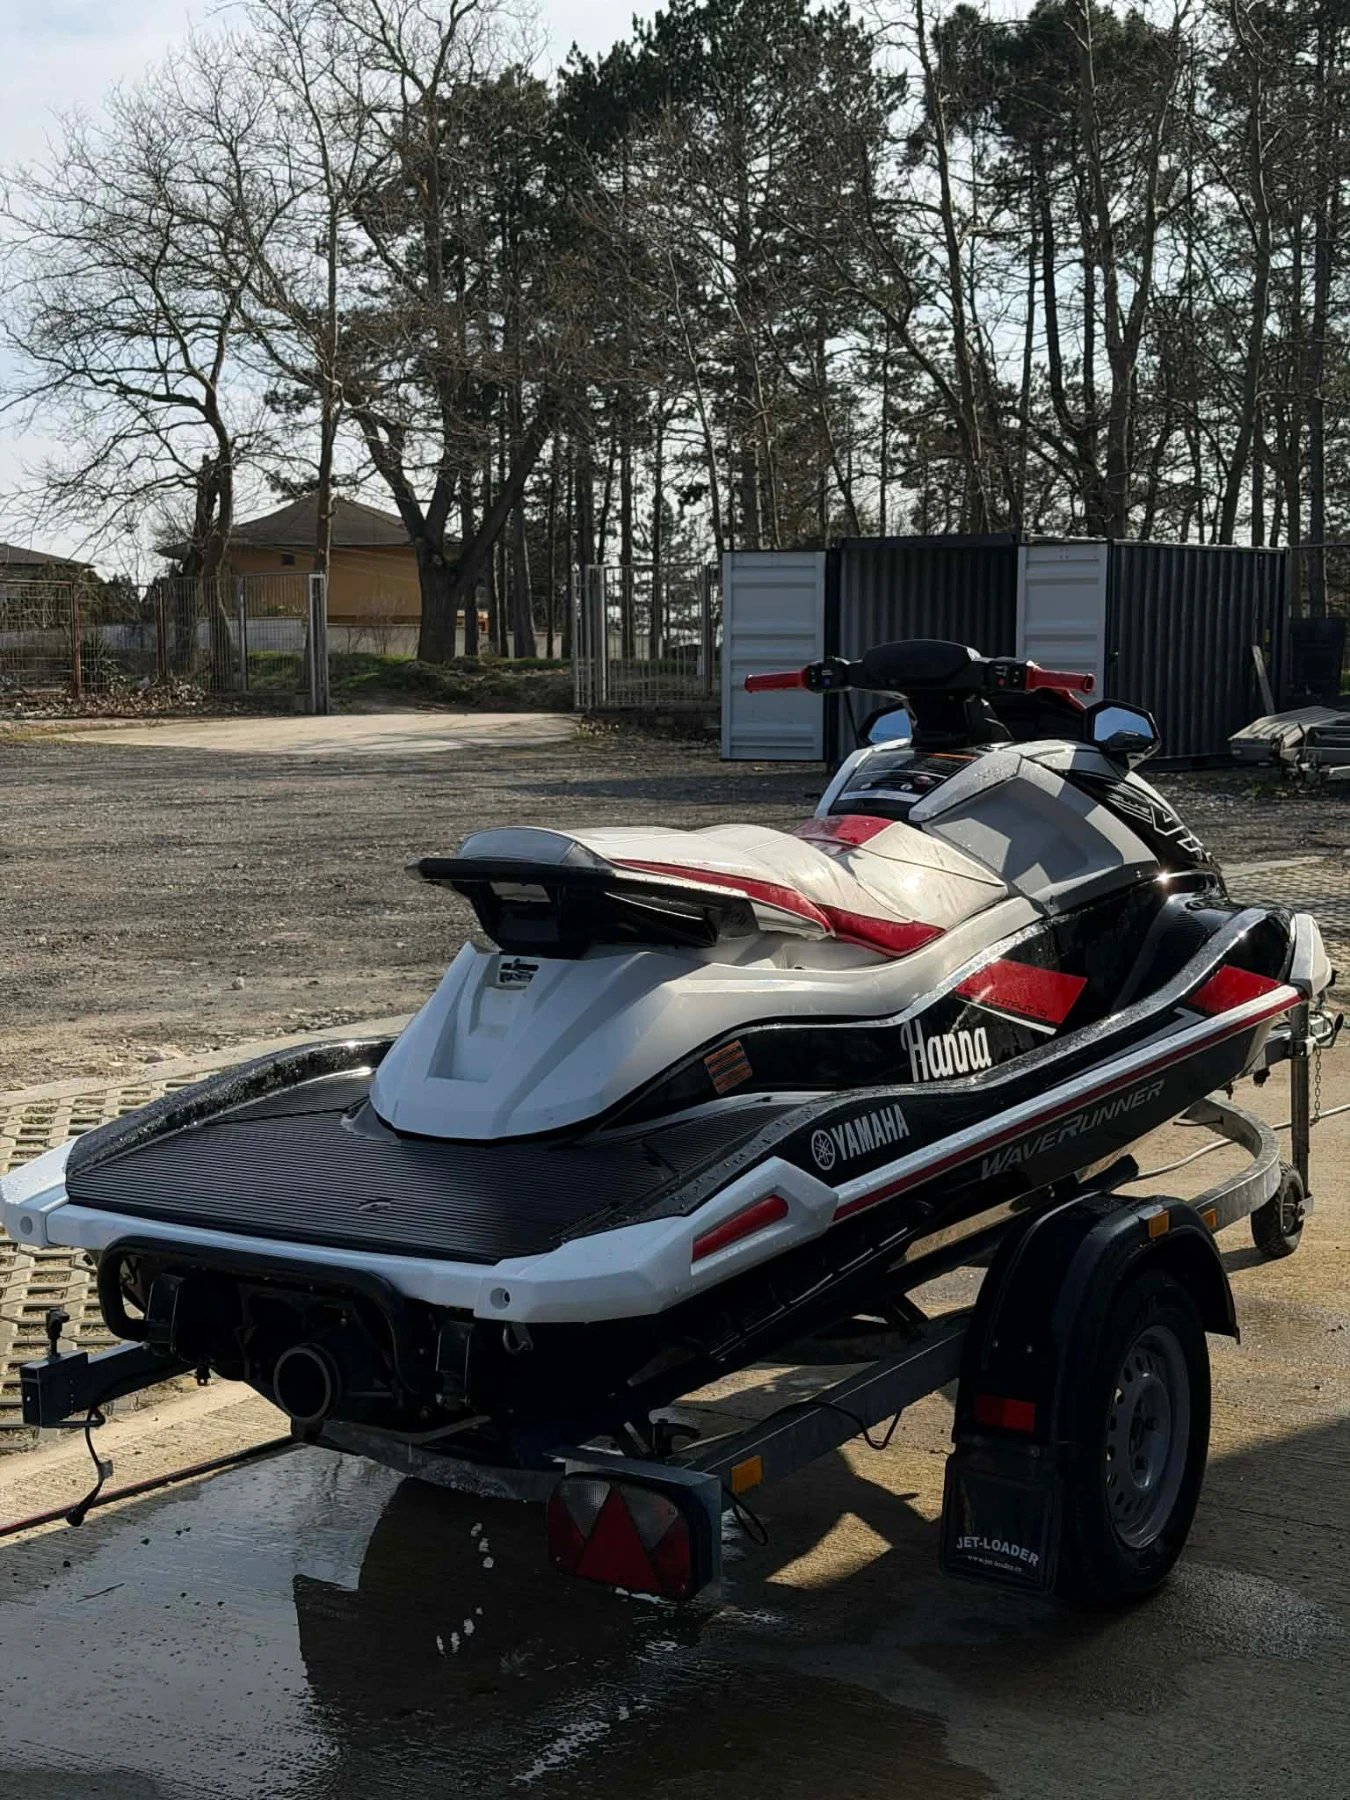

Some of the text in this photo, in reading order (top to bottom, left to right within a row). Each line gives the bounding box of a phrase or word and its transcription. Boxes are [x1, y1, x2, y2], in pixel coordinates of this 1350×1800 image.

[900, 1019, 992, 1082] Hanna
[830, 1104, 910, 1160] YAMAHA
[957, 1536, 1040, 1567] JET-LOADER
